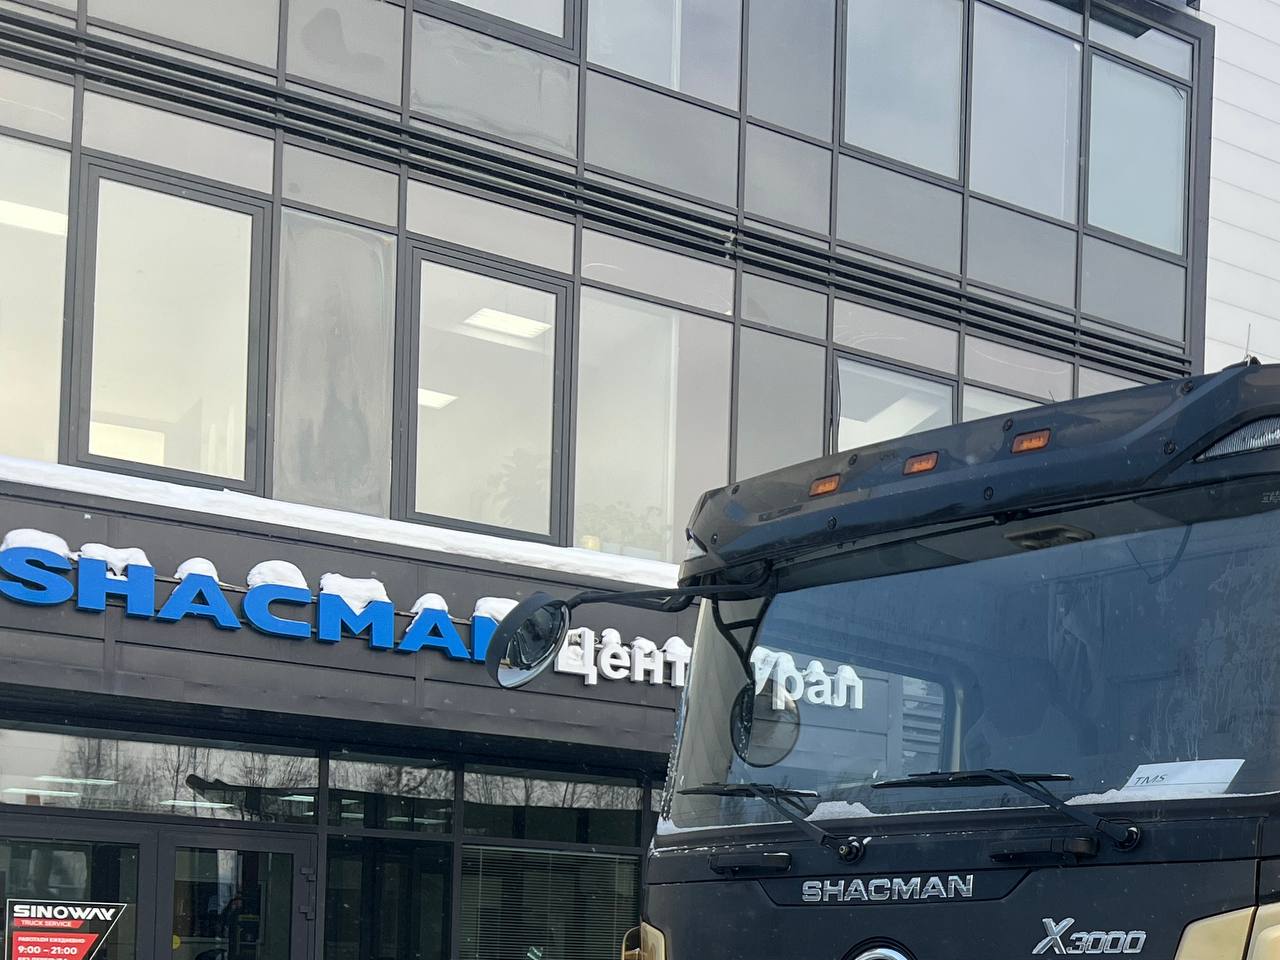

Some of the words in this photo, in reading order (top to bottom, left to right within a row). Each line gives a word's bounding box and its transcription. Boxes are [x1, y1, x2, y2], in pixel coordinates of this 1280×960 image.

[554, 627, 693, 687] Цент
[750, 646, 863, 710] Урал
[801, 874, 974, 902] SHACMAN
[13, 904, 116, 920] SINOWAY
[21, 919, 44, 927] TRUCK
[45, 920, 72, 928] SERVICE
[1031, 916, 1147, 955] X3000
[18, 946, 41, 954] 9:00
[50, 947, 77, 955] 21:00
